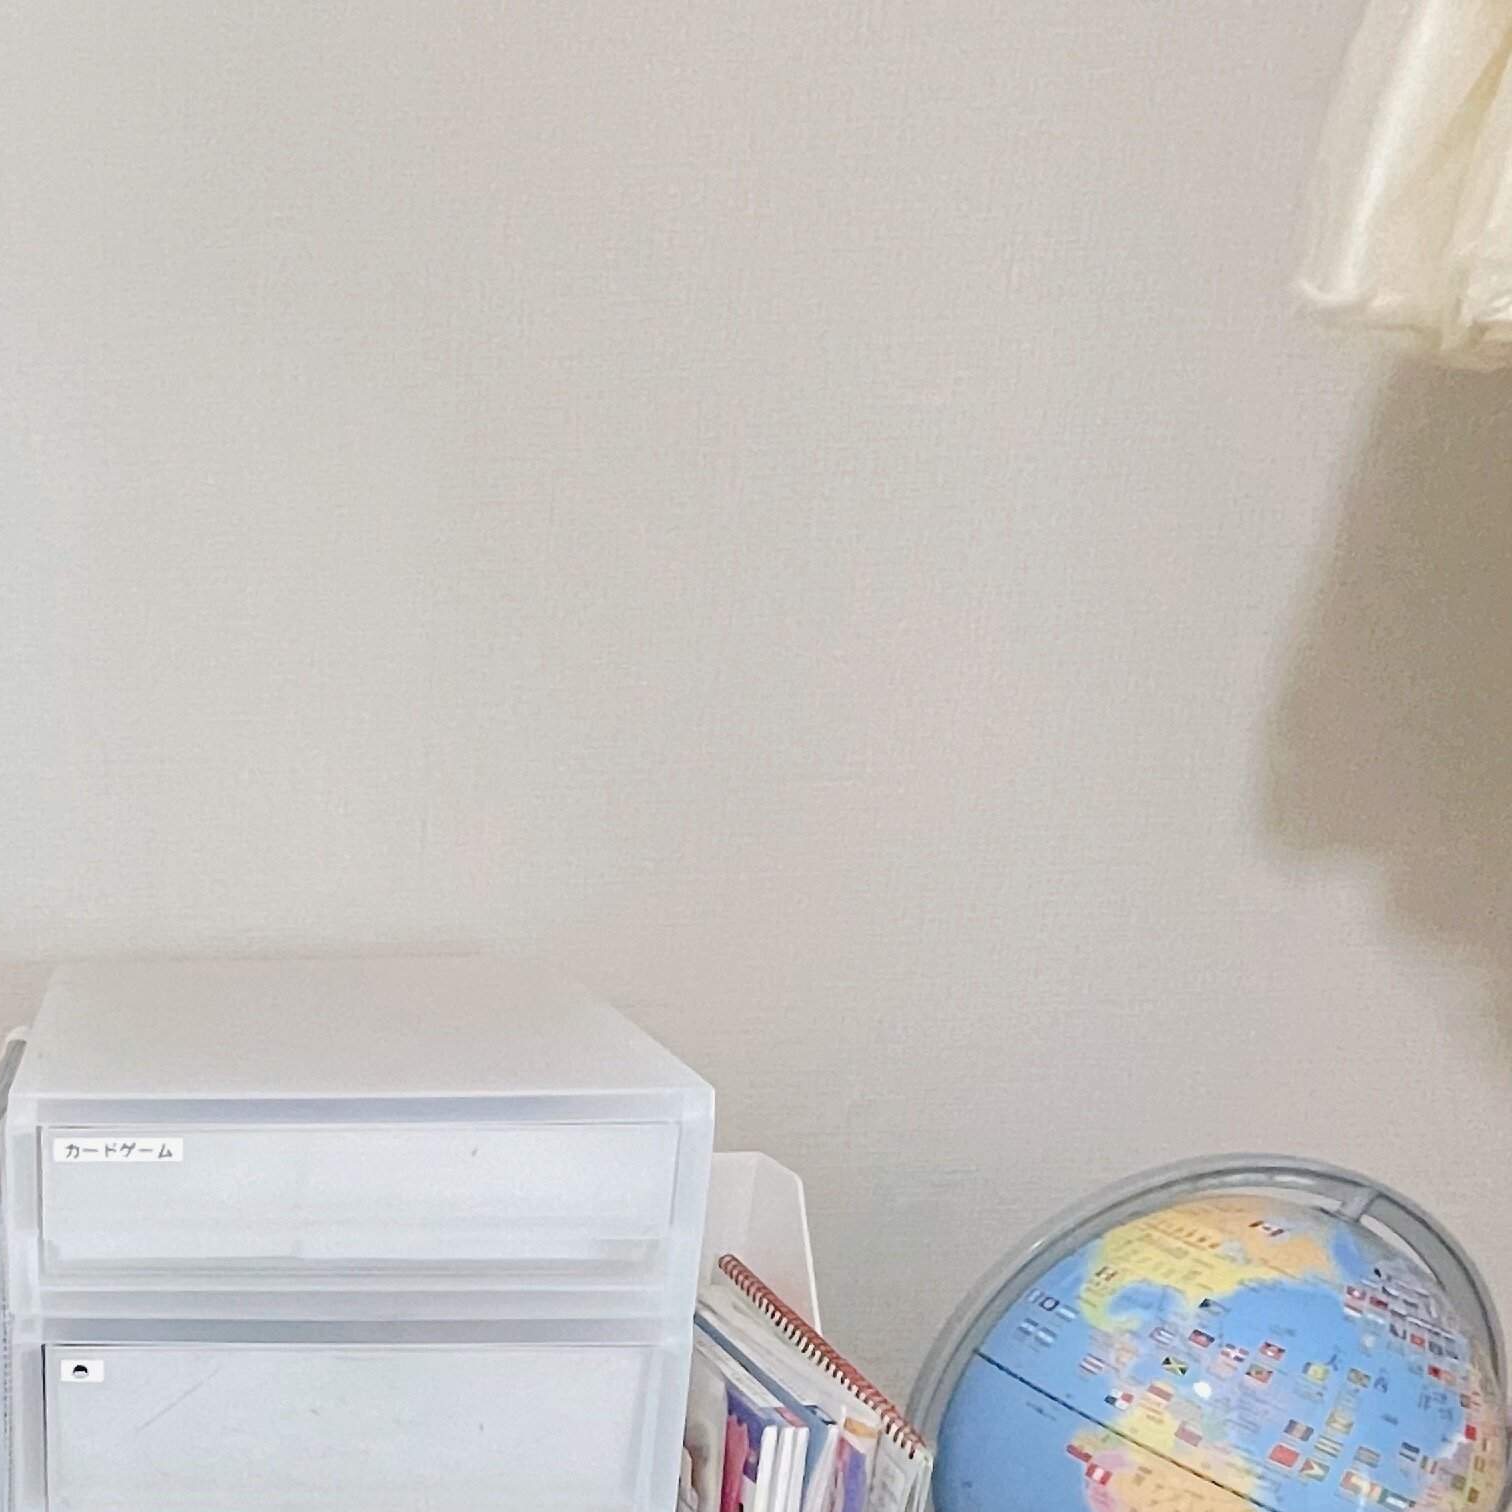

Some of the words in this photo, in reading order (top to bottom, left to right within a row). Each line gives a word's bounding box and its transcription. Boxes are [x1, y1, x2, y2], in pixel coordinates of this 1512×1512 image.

[65, 1142, 173, 1159] カードゲーム
